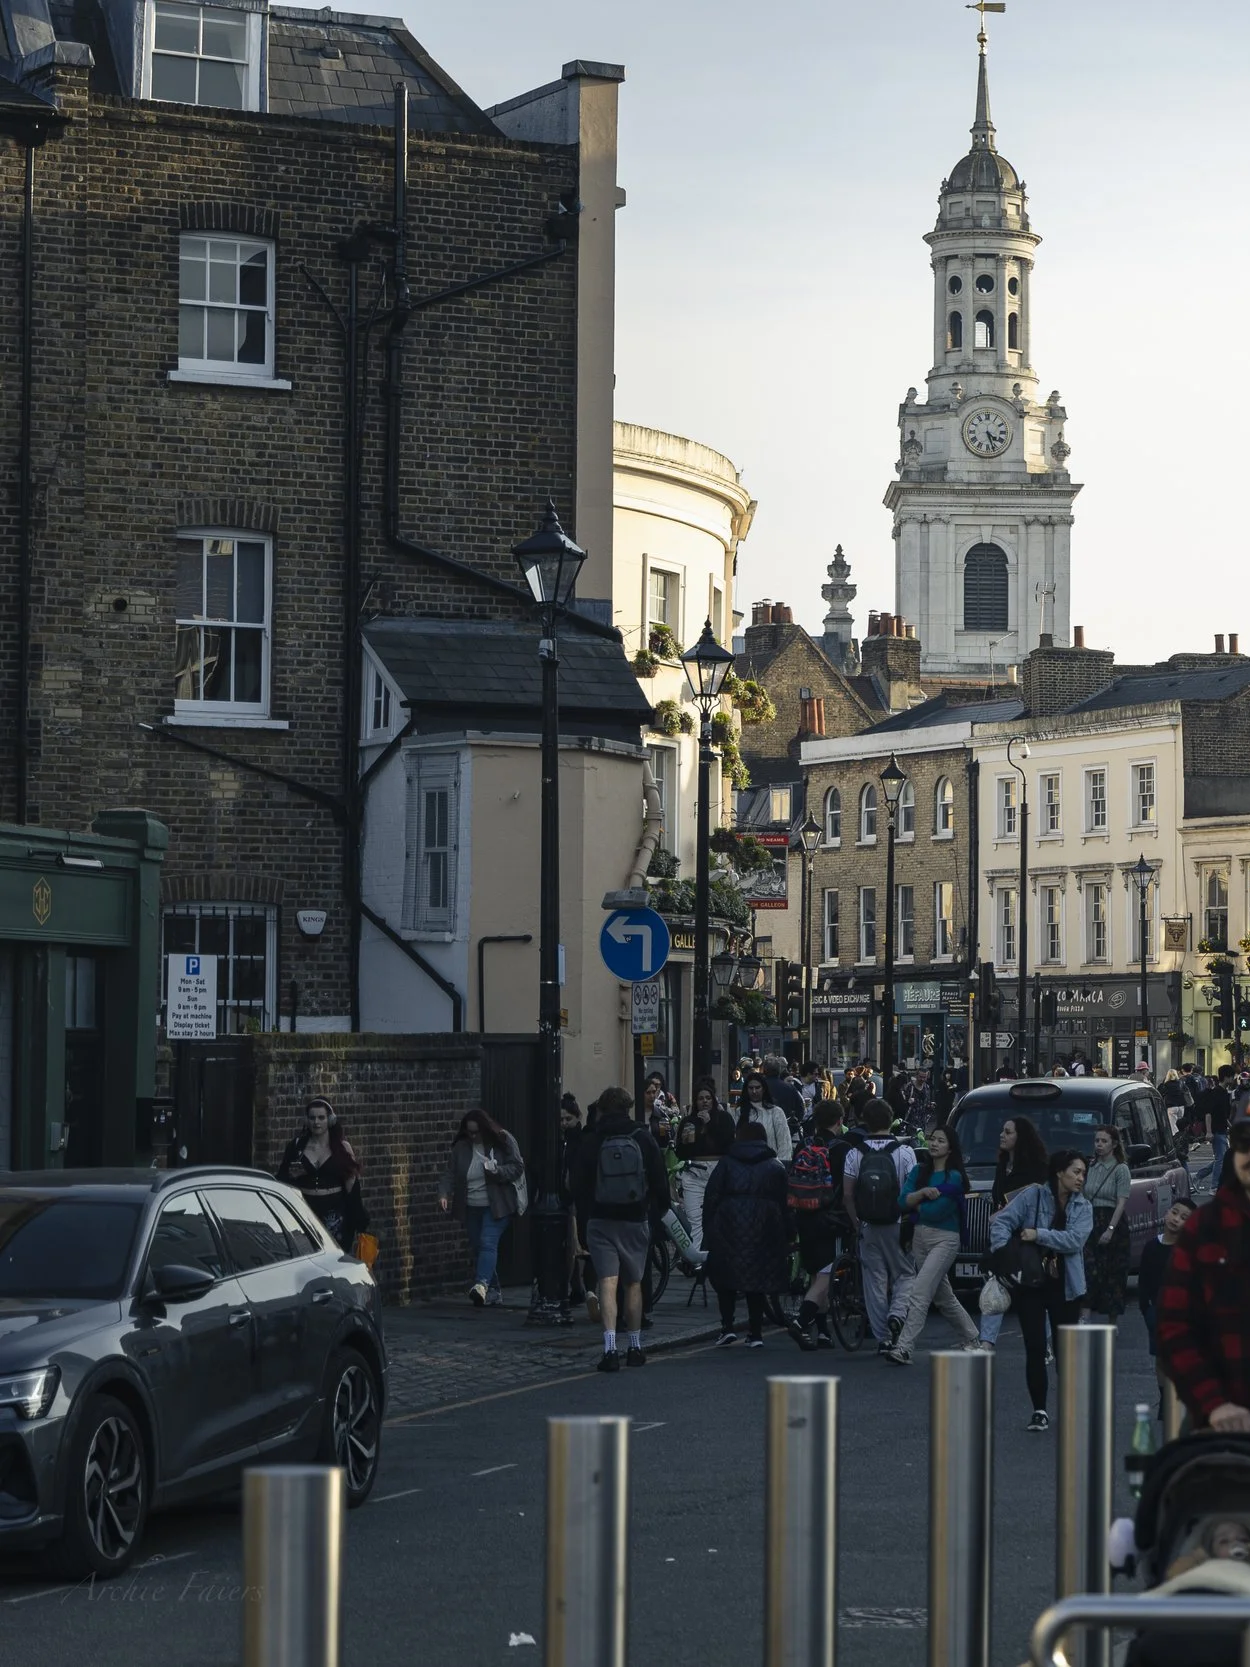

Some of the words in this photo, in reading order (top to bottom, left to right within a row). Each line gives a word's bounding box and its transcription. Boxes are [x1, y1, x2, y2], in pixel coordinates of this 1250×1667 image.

[189, 958, 199, 974] P
[823, 995, 827, 1003] &
[828, 995, 844, 1003] VIDEO
[844, 994, 870, 1004] EXCHANGE
[172, 1012, 182, 1020] Pay
[174, 1021, 193, 1029] Display
